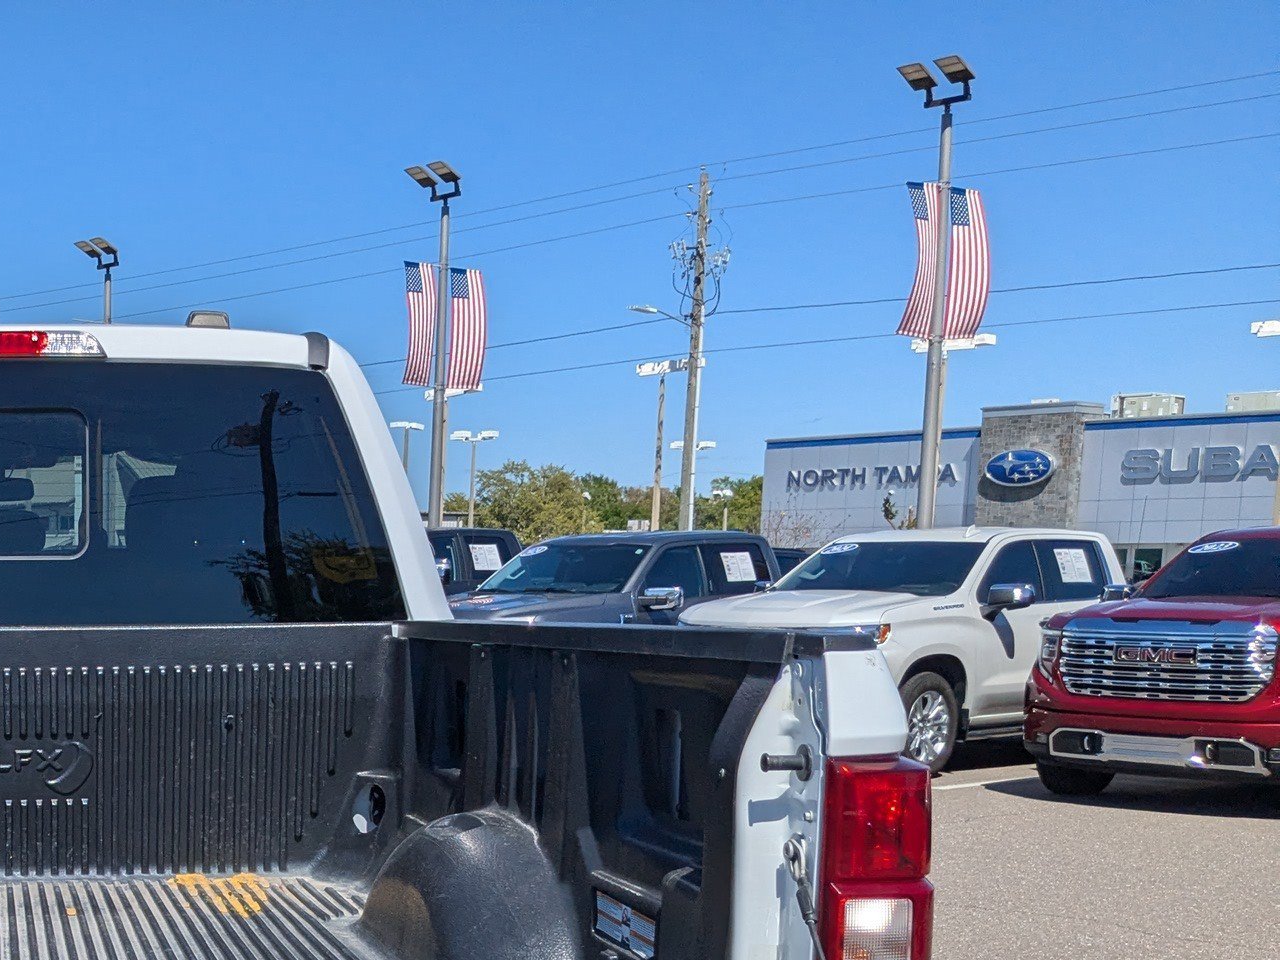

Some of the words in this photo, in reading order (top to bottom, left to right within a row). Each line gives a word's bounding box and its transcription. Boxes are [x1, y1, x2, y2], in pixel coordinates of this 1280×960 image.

[786, 467, 867, 488] NORTH
[874, 463, 958, 485] TAMA
[1117, 647, 1196, 662] GMC
